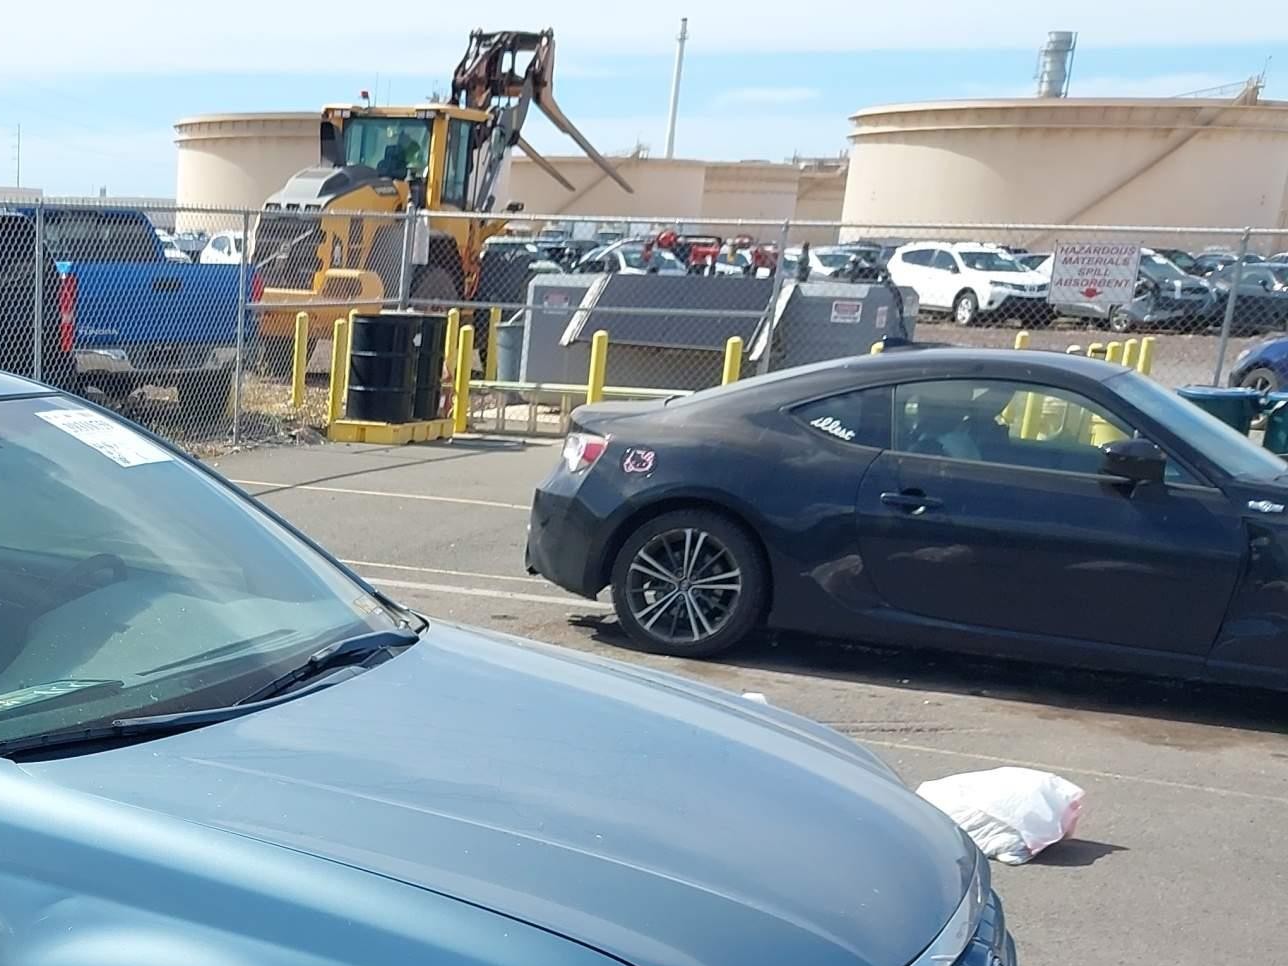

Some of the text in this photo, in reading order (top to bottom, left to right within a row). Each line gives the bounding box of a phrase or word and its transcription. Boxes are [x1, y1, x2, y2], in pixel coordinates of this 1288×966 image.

[1060, 246, 1137, 256] HAZARDOUS
[1061, 255, 1130, 266] MATERIALS
[1077, 267, 1110, 277] SPILL
[1055, 278, 1131, 288] ABSORBENT
